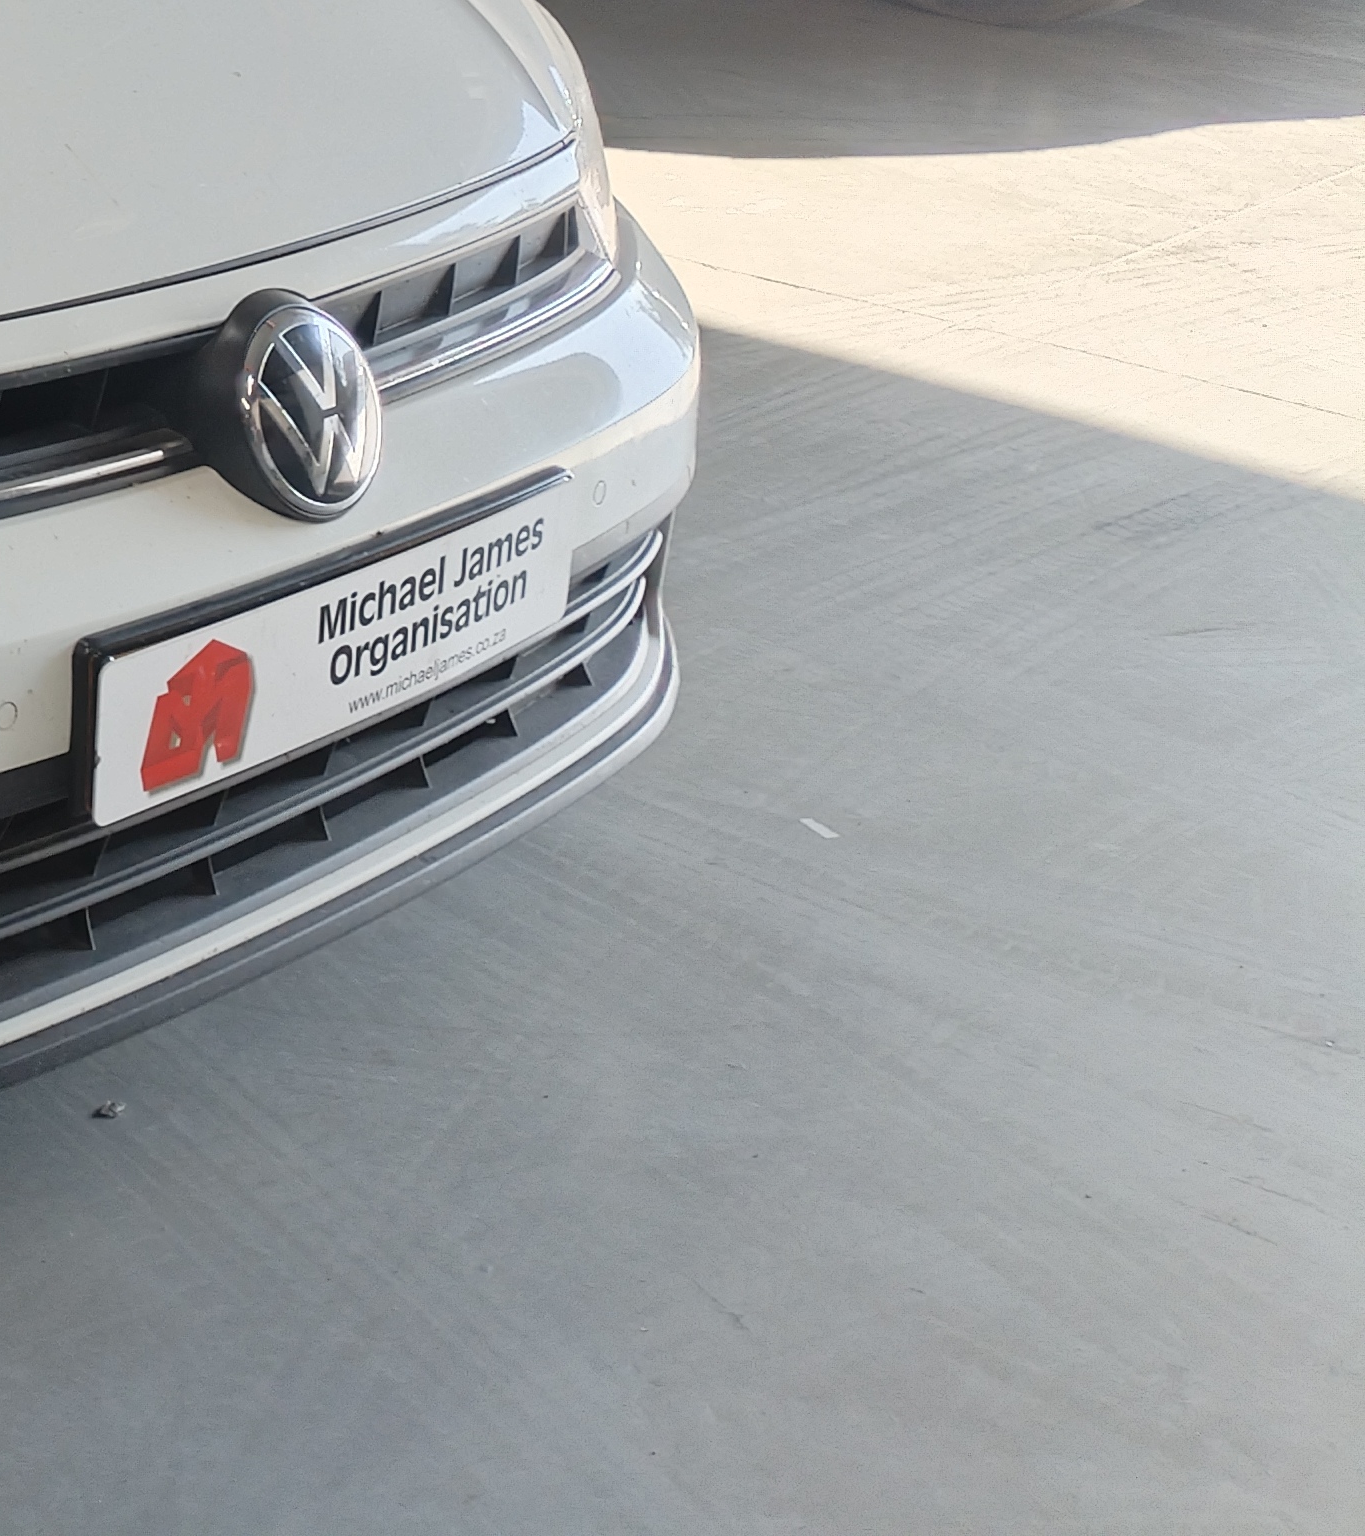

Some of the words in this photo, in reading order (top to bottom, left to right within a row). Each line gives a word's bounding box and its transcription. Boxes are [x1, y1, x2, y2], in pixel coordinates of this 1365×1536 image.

[317, 555, 448, 645] Michael
[453, 516, 545, 587] James
[329, 566, 528, 687] Organisation
[347, 627, 508, 714] www.michaeljames.co.za
